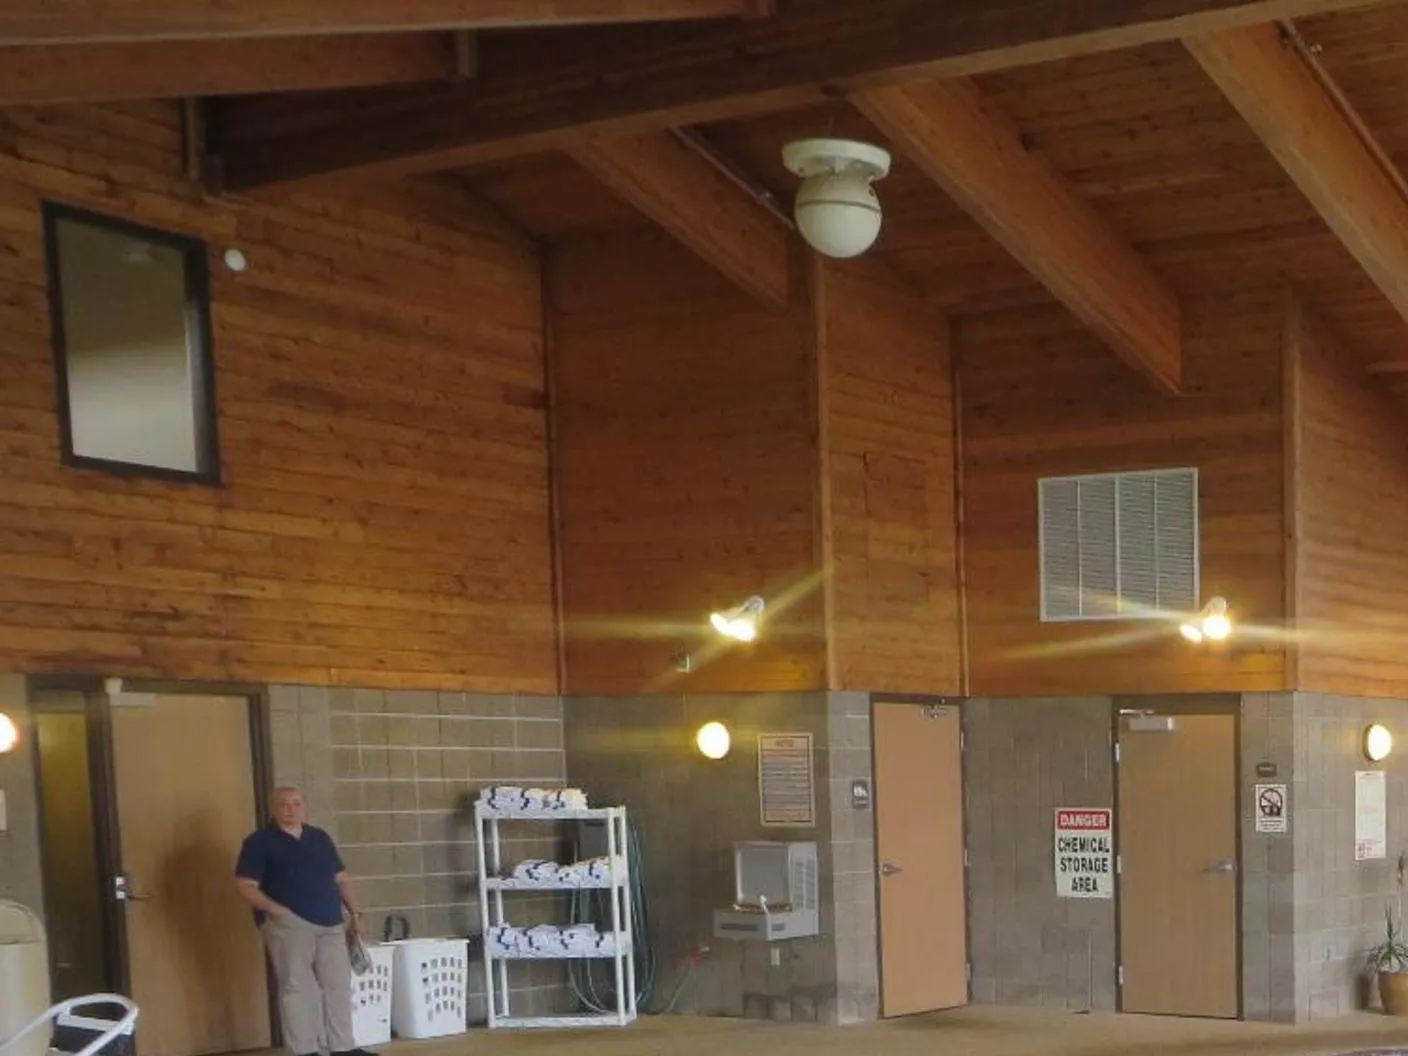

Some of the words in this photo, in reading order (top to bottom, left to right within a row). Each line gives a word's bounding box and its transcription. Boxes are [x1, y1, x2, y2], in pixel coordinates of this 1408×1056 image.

[1060, 813, 1107, 827] DANGER
[1058, 836, 1110, 853] CHEMICAL
[1060, 857, 1108, 873] STORAGE
[1071, 876, 1099, 892] AREA
